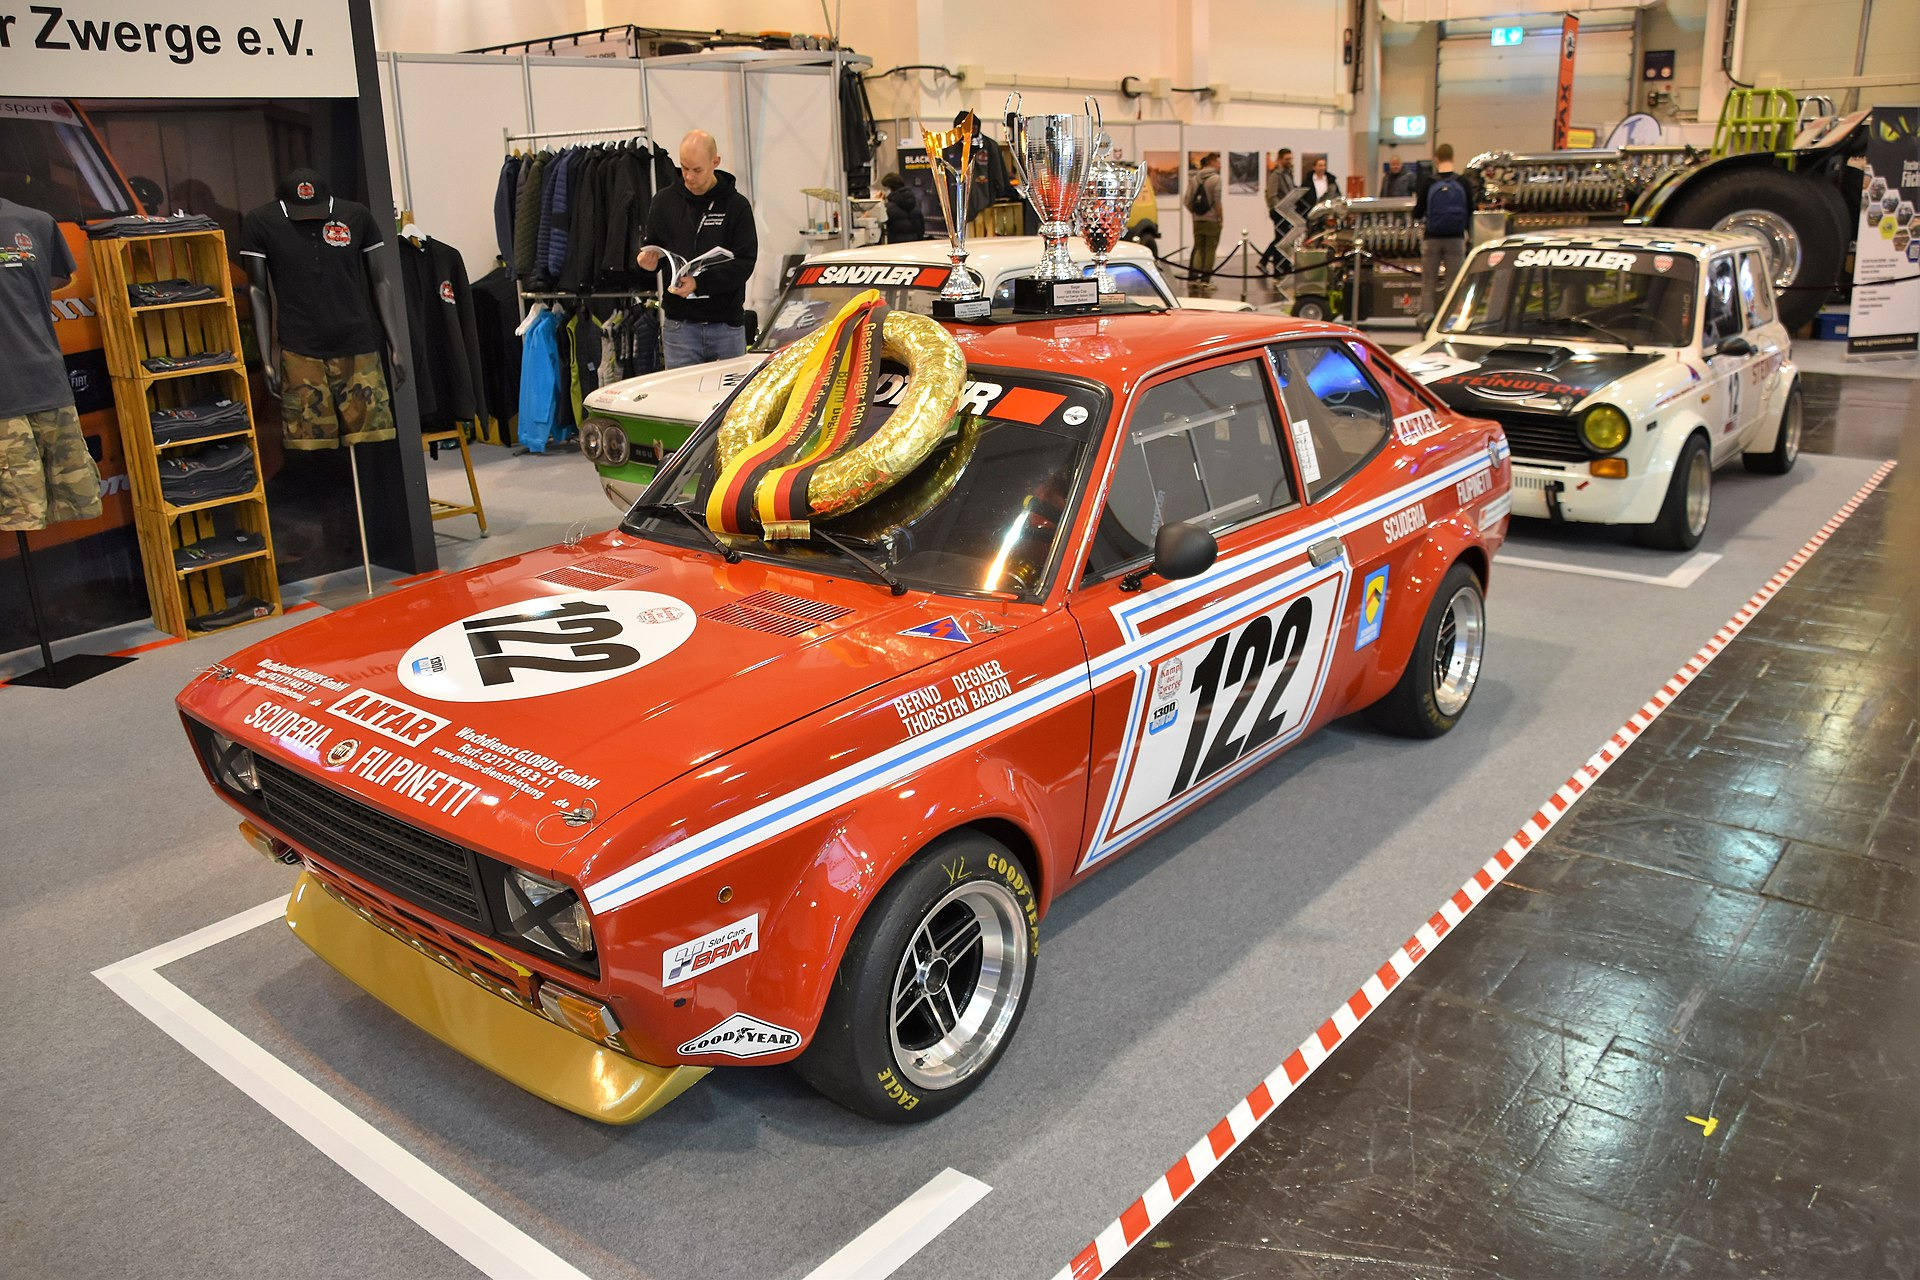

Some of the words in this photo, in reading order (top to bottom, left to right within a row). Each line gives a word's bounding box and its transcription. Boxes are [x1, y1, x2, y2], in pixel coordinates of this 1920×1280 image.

[30, 6, 222, 65] Zwerge
[237, 18, 314, 56] e.V.
[818, 266, 920, 287] SANDTLER
[1513, 249, 1637, 272] SANDTLER
[824, 350, 841, 387] Kampf
[854, 322, 877, 403] Gesamtsieger
[812, 389, 826, 407] der
[848, 401, 866, 428] 1300
[786, 411, 817, 446] Zwerge
[1400, 414, 1438, 437] ANTAR
[1456, 468, 1493, 506] FILIPINETTI
[1382, 502, 1428, 544] SCUDERIA
[462, 601, 641, 687] 122
[292, 668, 324, 684] GLOBUS
[894, 685, 942, 718] BERND
[951, 660, 1005, 693] DEGNER
[902, 695, 969, 738] THORSTEN
[968, 677, 1013, 709] BABON
[1153, 702, 1176, 720] 1300
[1168, 596, 1312, 800] 122
[243, 701, 334, 755] SCUDERIA
[334, 694, 437, 742] ANTAR
[455, 726, 520, 755] Wachdienst
[514, 749, 564, 775] GLOBUS
[557, 769, 601, 790] GmbH
[458, 743, 481, 758] Ruf:
[349, 746, 482, 818] FILIPINETTI
[431, 746, 546, 800] www.globus-dienstleistung
[551, 797, 571, 809] .de
[987, 852, 1039, 957] GOODYEAR
[691, 933, 753, 972] BRM
[708, 934, 726, 949] Slot
[727, 927, 746, 940] Cars
[684, 1028, 793, 1052] GOODYEAR
[877, 1067, 919, 1110] EAGLE
